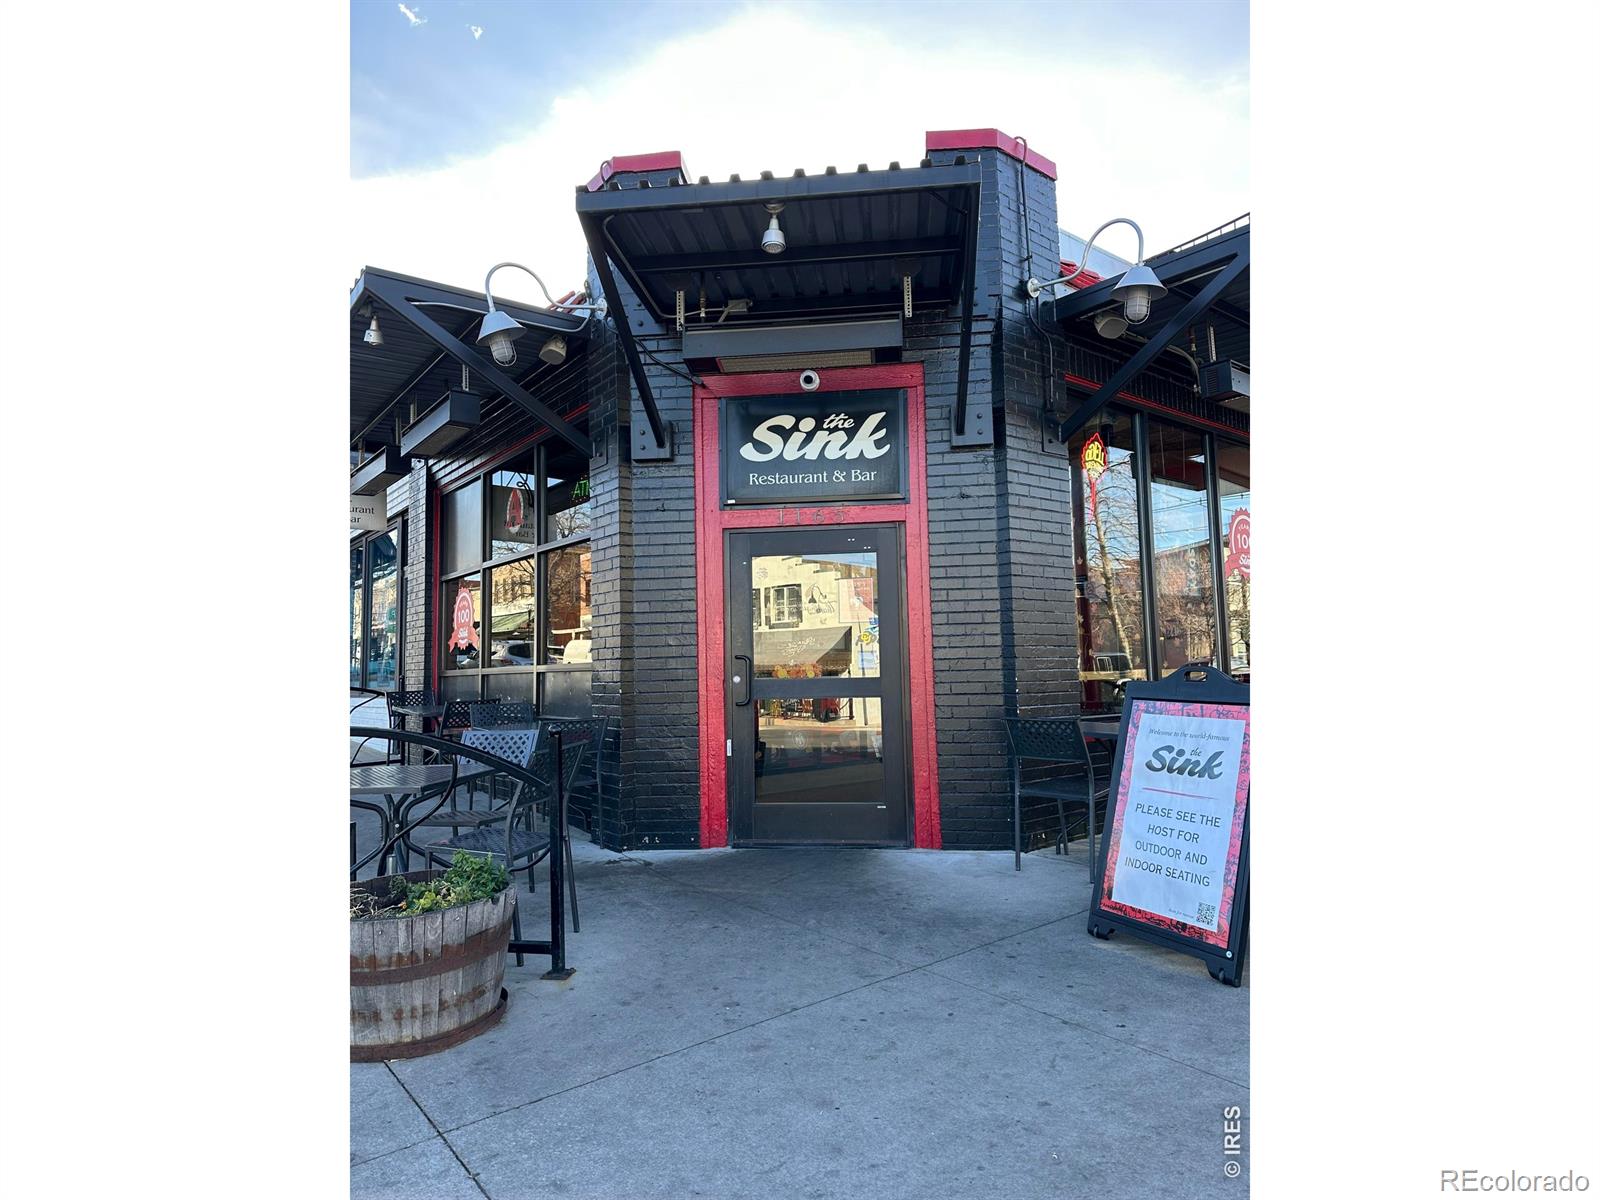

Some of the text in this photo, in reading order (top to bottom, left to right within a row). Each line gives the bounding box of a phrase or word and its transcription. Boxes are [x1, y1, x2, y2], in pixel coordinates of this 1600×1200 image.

[822, 412, 855, 429] the
[739, 411, 891, 462] Sink
[749, 469, 877, 485] Restaurant & Bar
[777, 506, 845, 525] 1165
[458, 608, 470, 623] 100
[1148, 728, 1173, 737] Welcome
[1189, 732, 1230, 742] world-famous
[1189, 747, 1202, 757] the
[1145, 744, 1225, 780] Sink
[1135, 803, 1221, 828] PLEASE SEE THE
[1147, 823, 1199, 843] HOST FOR
[1135, 840, 1208, 865] OUTDOOR AND
[1124, 856, 1210, 887] INDOOR SEATING
